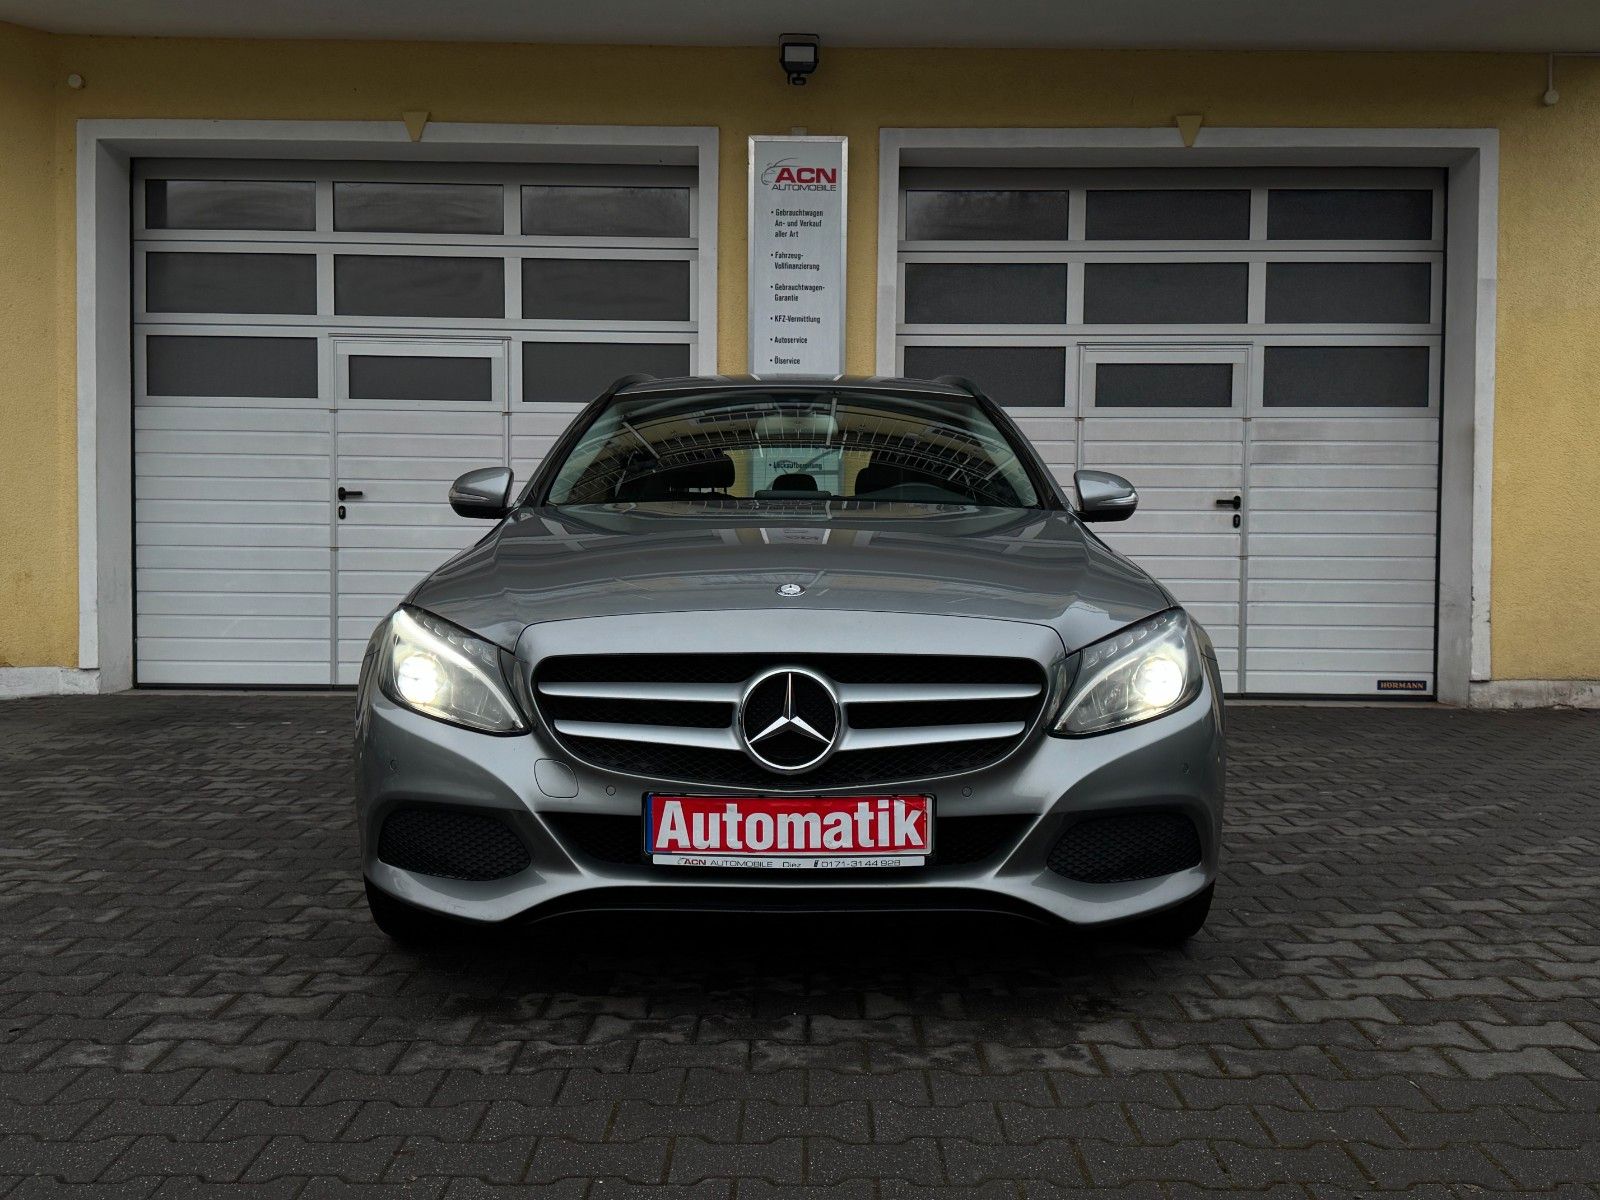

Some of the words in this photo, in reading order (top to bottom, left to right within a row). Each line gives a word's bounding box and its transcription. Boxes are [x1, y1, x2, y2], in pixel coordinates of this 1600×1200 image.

[775, 168, 837, 183] ACN
[771, 184, 837, 192] AUTOMOBILE
[775, 208, 824, 218] Gebrauchtwagen
[775, 252, 804, 260] Fahrzeug-
[774, 283, 825, 292] Gebrauchtwagen-
[774, 315, 821, 323] KFZ-Vermittlung
[774, 356, 800, 364] Ölservice
[655, 800, 924, 850] Automatik
[710, 860, 773, 868] AUTOMOBILE
